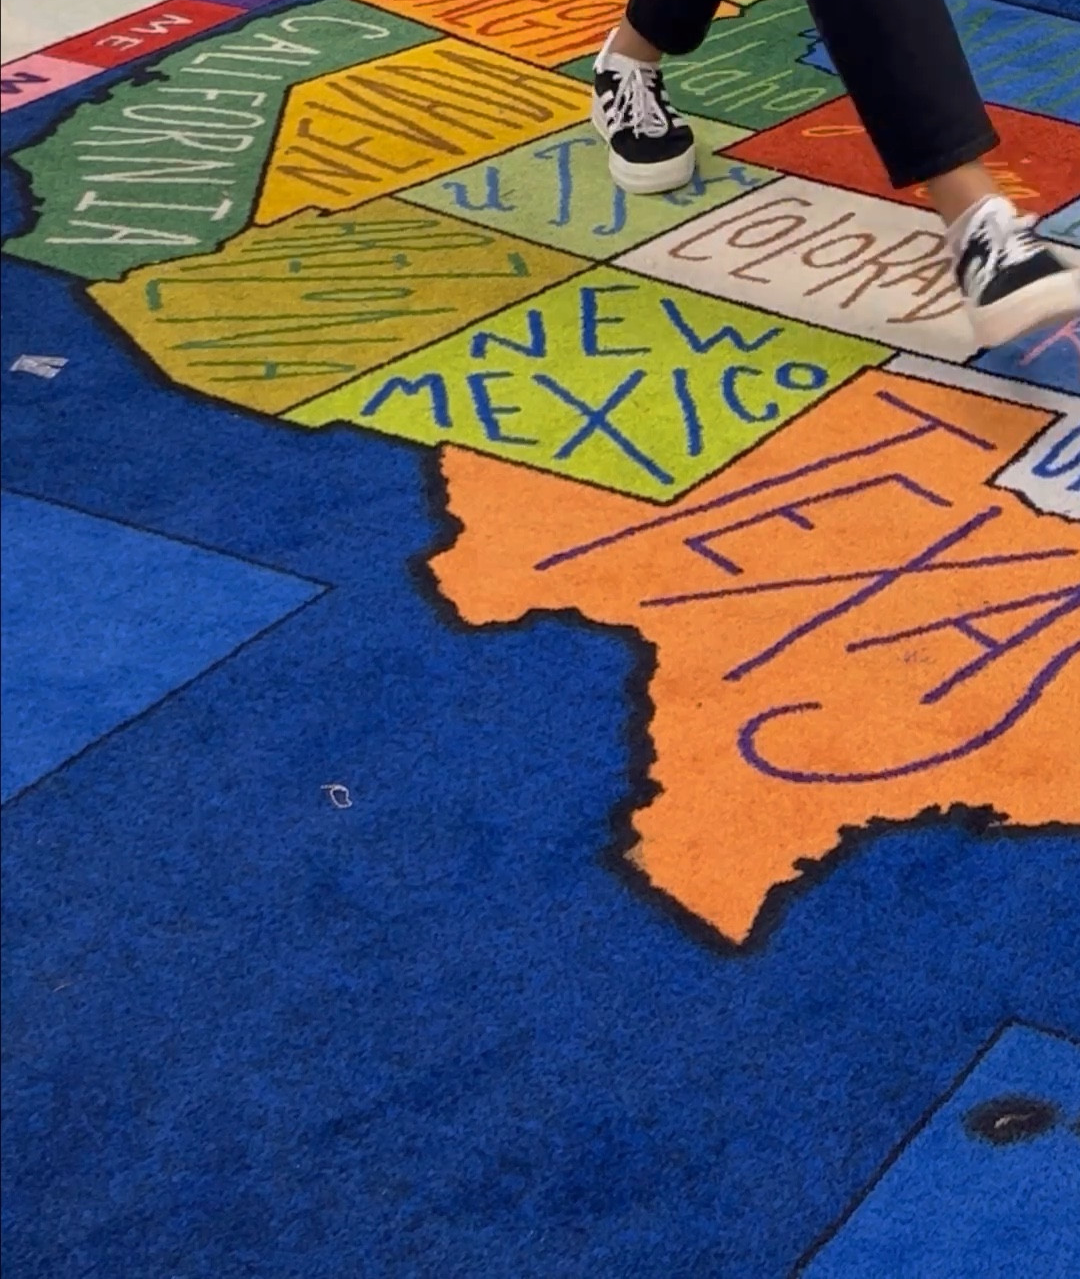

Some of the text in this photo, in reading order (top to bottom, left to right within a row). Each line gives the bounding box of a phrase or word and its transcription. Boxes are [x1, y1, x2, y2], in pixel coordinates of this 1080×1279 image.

[94, 13, 194, 52] ME
[45, 15, 391, 246] CALIFORNIA
[276, 47, 585, 196] NEVADA
[470, 286, 784, 358] NEW
[361, 361, 829, 485] MEXICO
